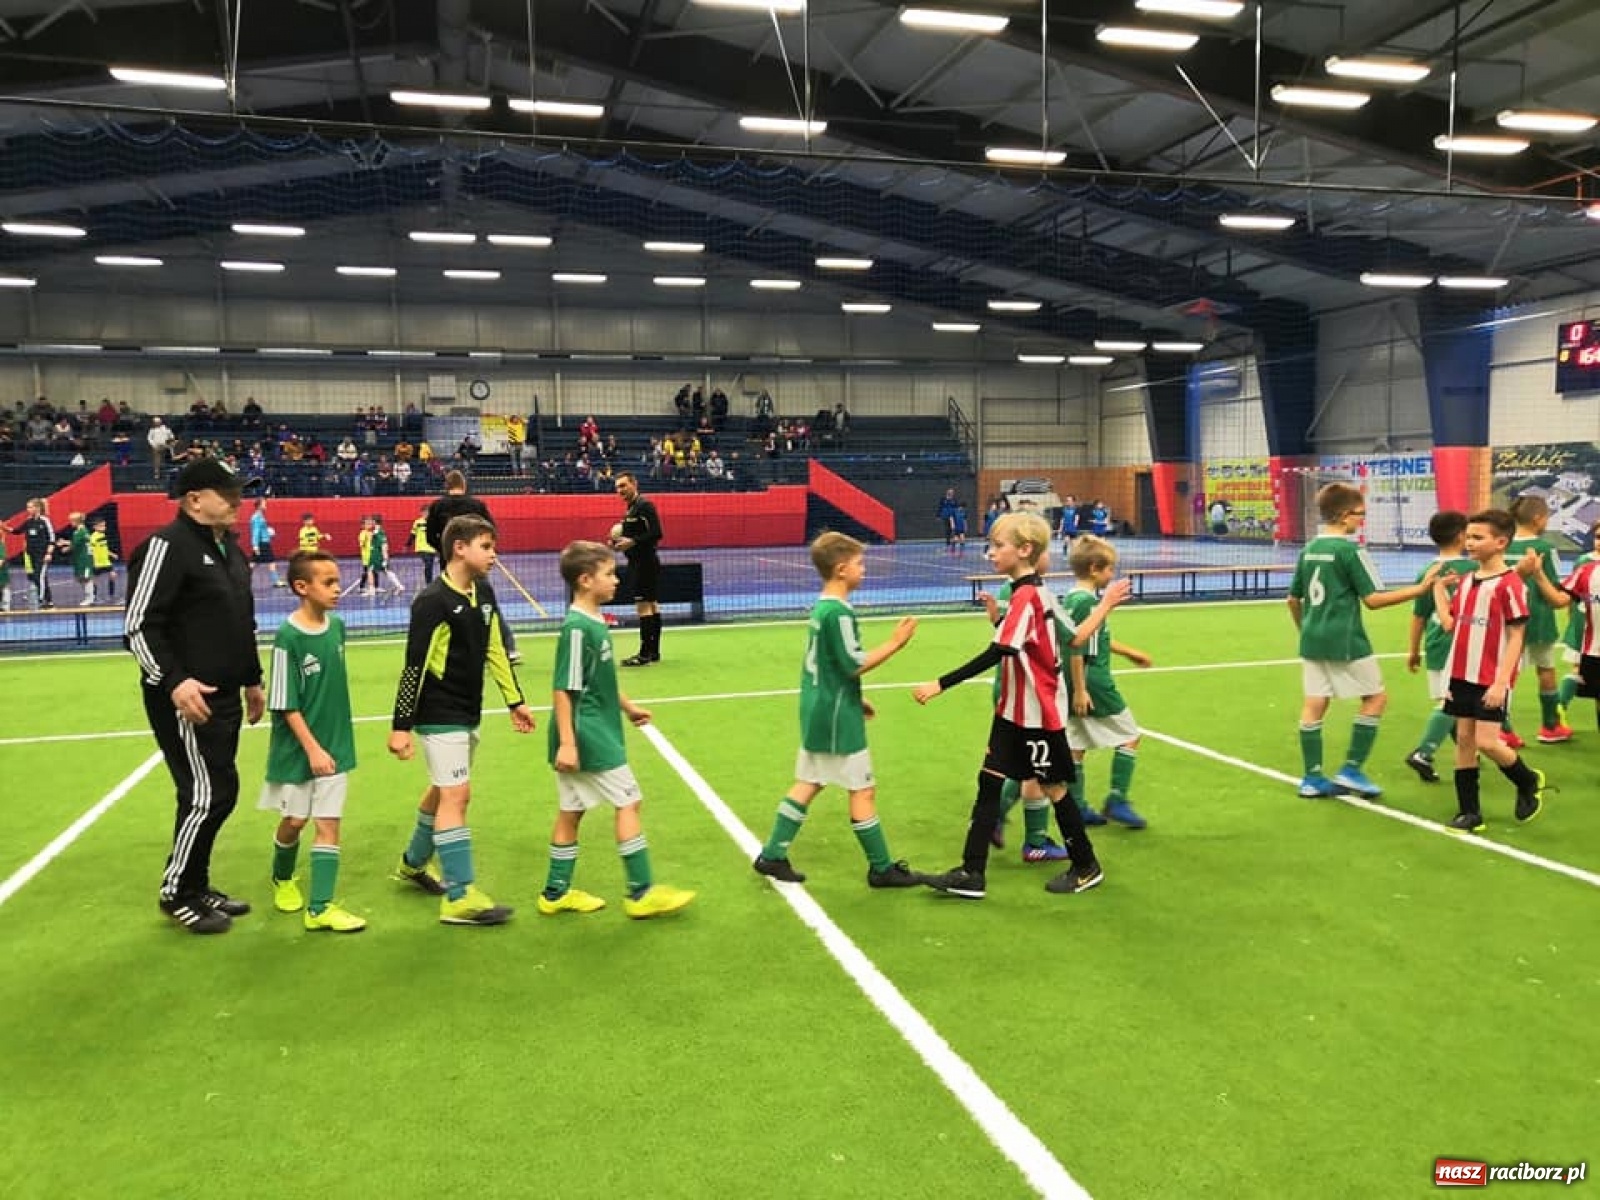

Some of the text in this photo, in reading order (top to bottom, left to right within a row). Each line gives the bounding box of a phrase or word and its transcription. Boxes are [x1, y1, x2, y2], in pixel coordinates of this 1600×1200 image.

[1569, 324, 1583, 341] 0
[1352, 457, 1437, 475] INTERNET
[1308, 566, 1326, 607] 6
[1026, 739, 1052, 768] 22
